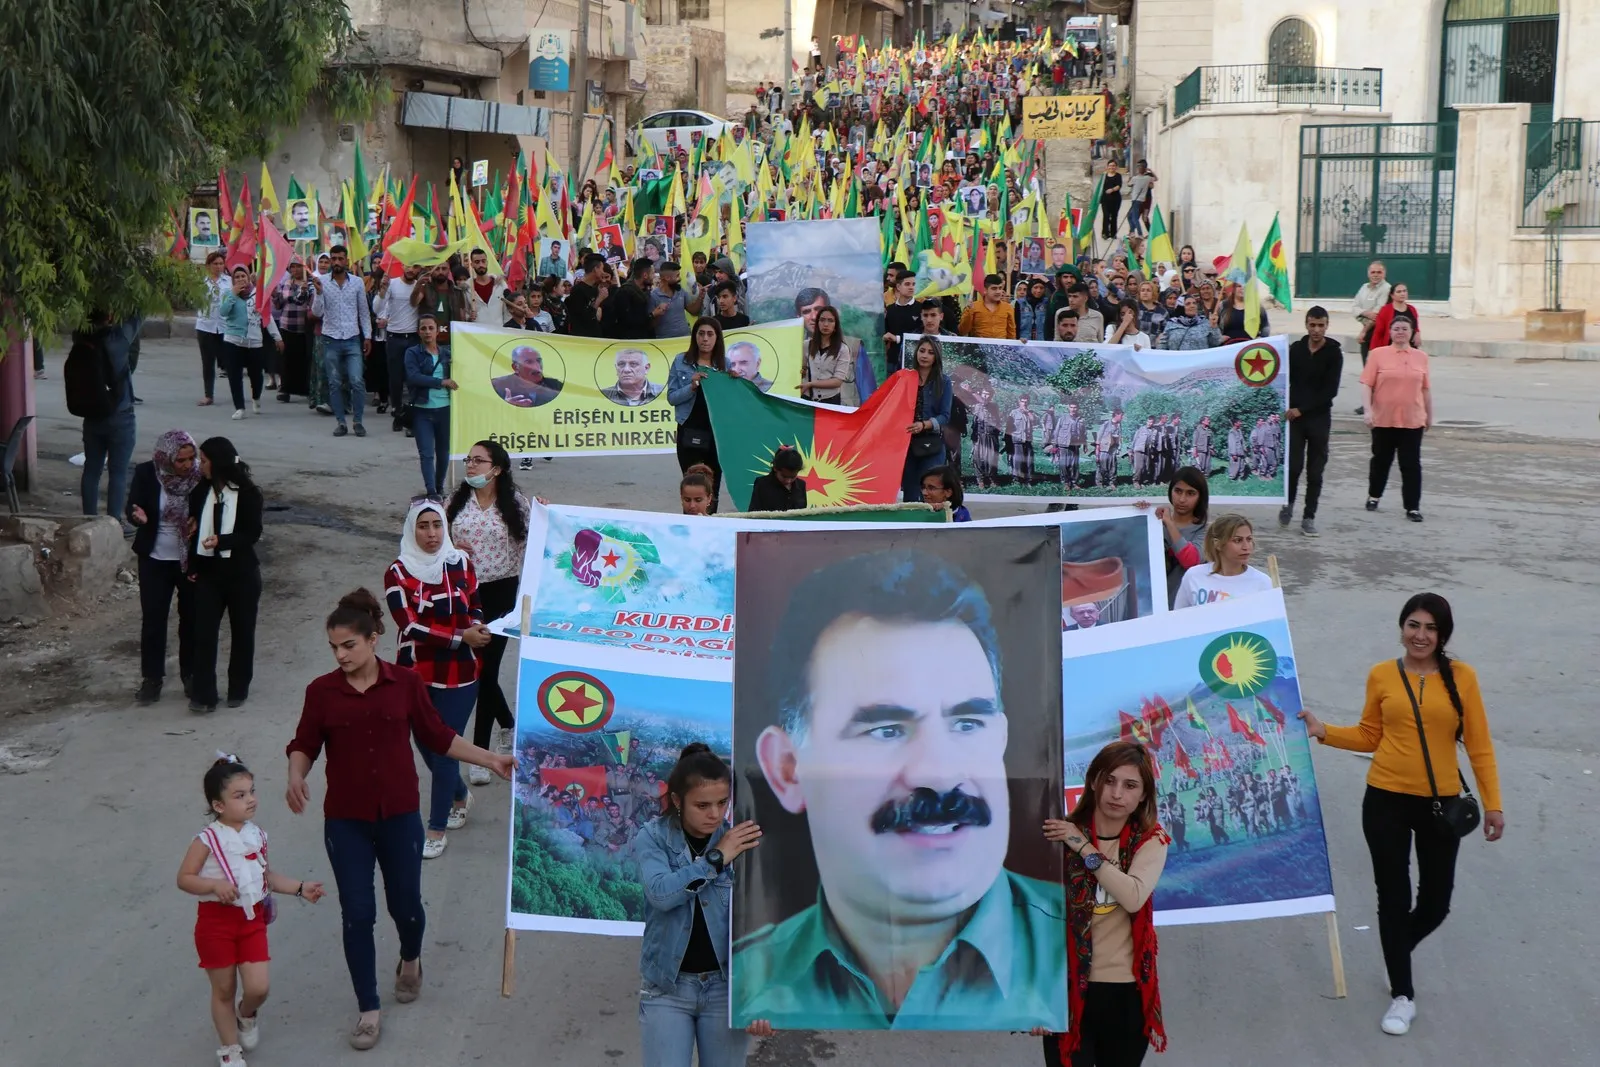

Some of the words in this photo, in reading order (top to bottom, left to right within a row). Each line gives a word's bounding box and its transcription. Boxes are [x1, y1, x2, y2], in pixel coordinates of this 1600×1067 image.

[553, 408, 614, 428] ÊRÎŞÊN
[620, 410, 634, 424] LI
[639, 409, 672, 424] SER
[555, 434, 569, 447] LI
[574, 432, 607, 448] SER
